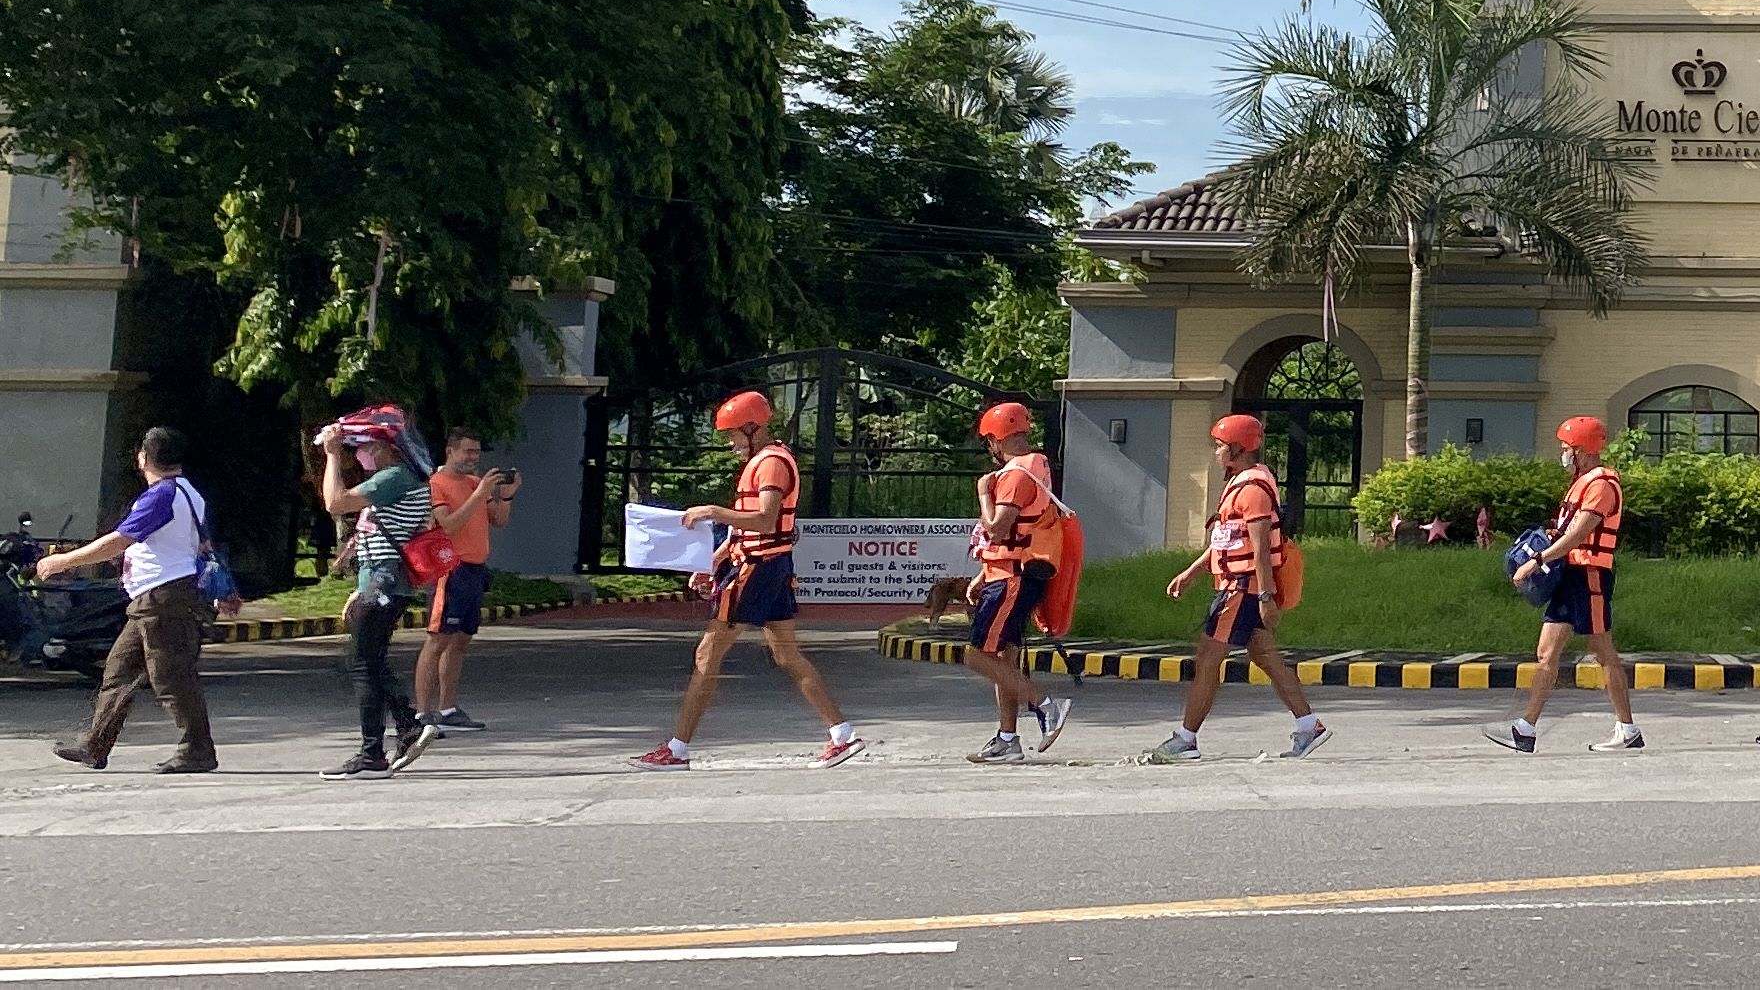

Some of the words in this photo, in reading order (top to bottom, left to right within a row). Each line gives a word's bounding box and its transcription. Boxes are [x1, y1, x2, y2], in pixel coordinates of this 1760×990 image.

[1615, 100, 1701, 133] Monte
[1670, 146, 1689, 156] DE
[802, 524, 858, 535] MONTECIELO
[860, 524, 925, 535] HOMEOWNERS
[927, 524, 973, 535] ASSOCIATI
[847, 541, 918, 557] NOTICE
[813, 560, 826, 570] To
[829, 560, 844, 570] all
[847, 562, 884, 573] guests
[888, 560, 897, 570] &
[797, 576, 823, 584] ease
[827, 574, 866, 584] submit
[869, 575, 881, 584] to
[884, 573, 903, 584] the
[796, 587, 811, 597] ith
[814, 587, 913, 600] Protocol/Security
